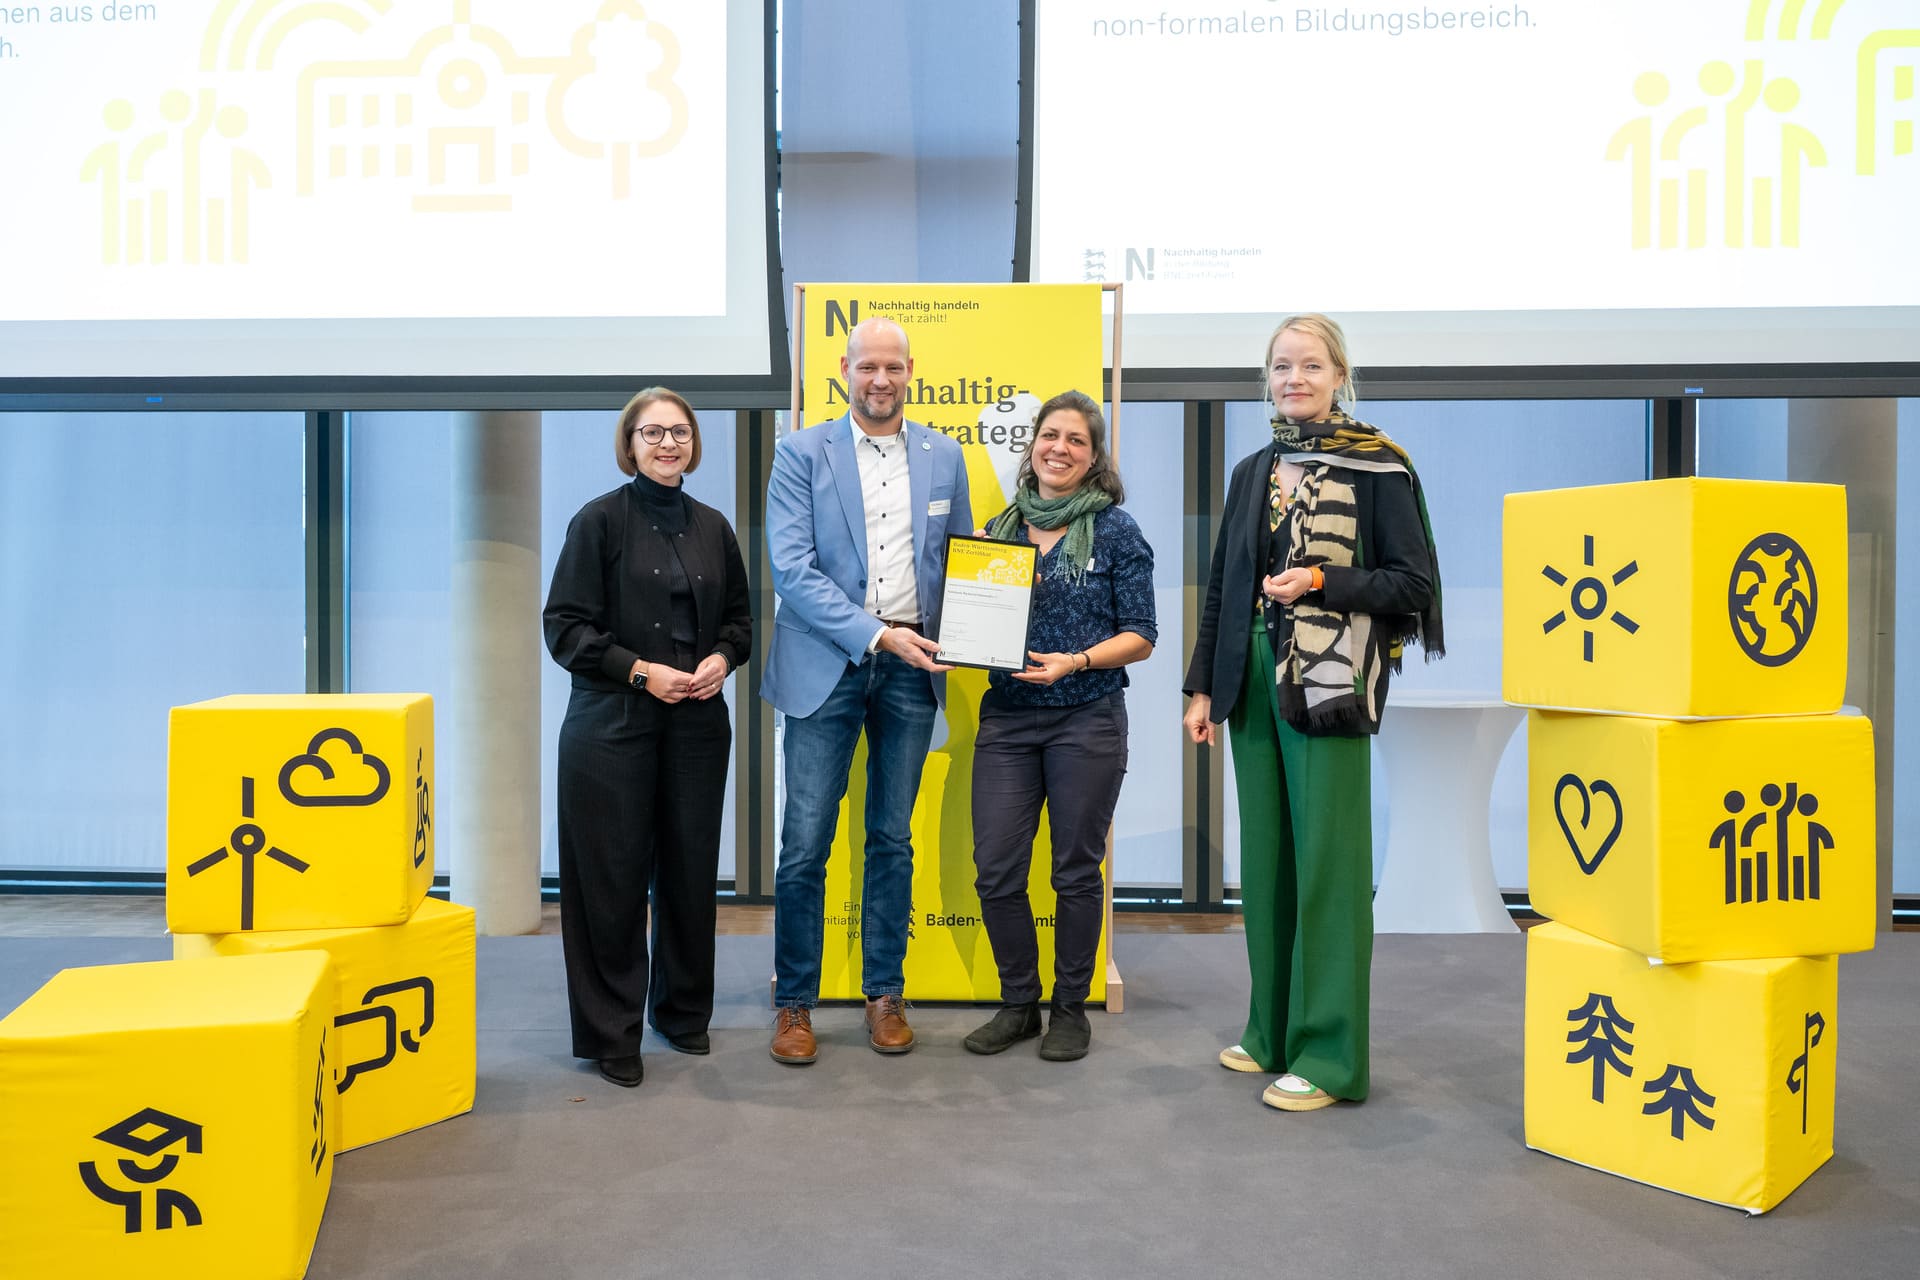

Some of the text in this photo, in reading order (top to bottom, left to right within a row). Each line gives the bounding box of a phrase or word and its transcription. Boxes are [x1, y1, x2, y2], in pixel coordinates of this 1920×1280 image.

[49, 6, 93, 23] aus
[102, 0, 156, 22] dem
[1093, 4, 1537, 37] non-formalen Bildungsbereich.
[1163, 247, 1262, 258] Nachhaltig handeln
[869, 300, 980, 312] Nachhaltig handeln
[897, 313, 914, 323] Tat
[917, 313, 947, 323] zählt!
[843, 901, 861, 911] Ein
[823, 915, 861, 926] nitiativ
[846, 931, 860, 939] vo
